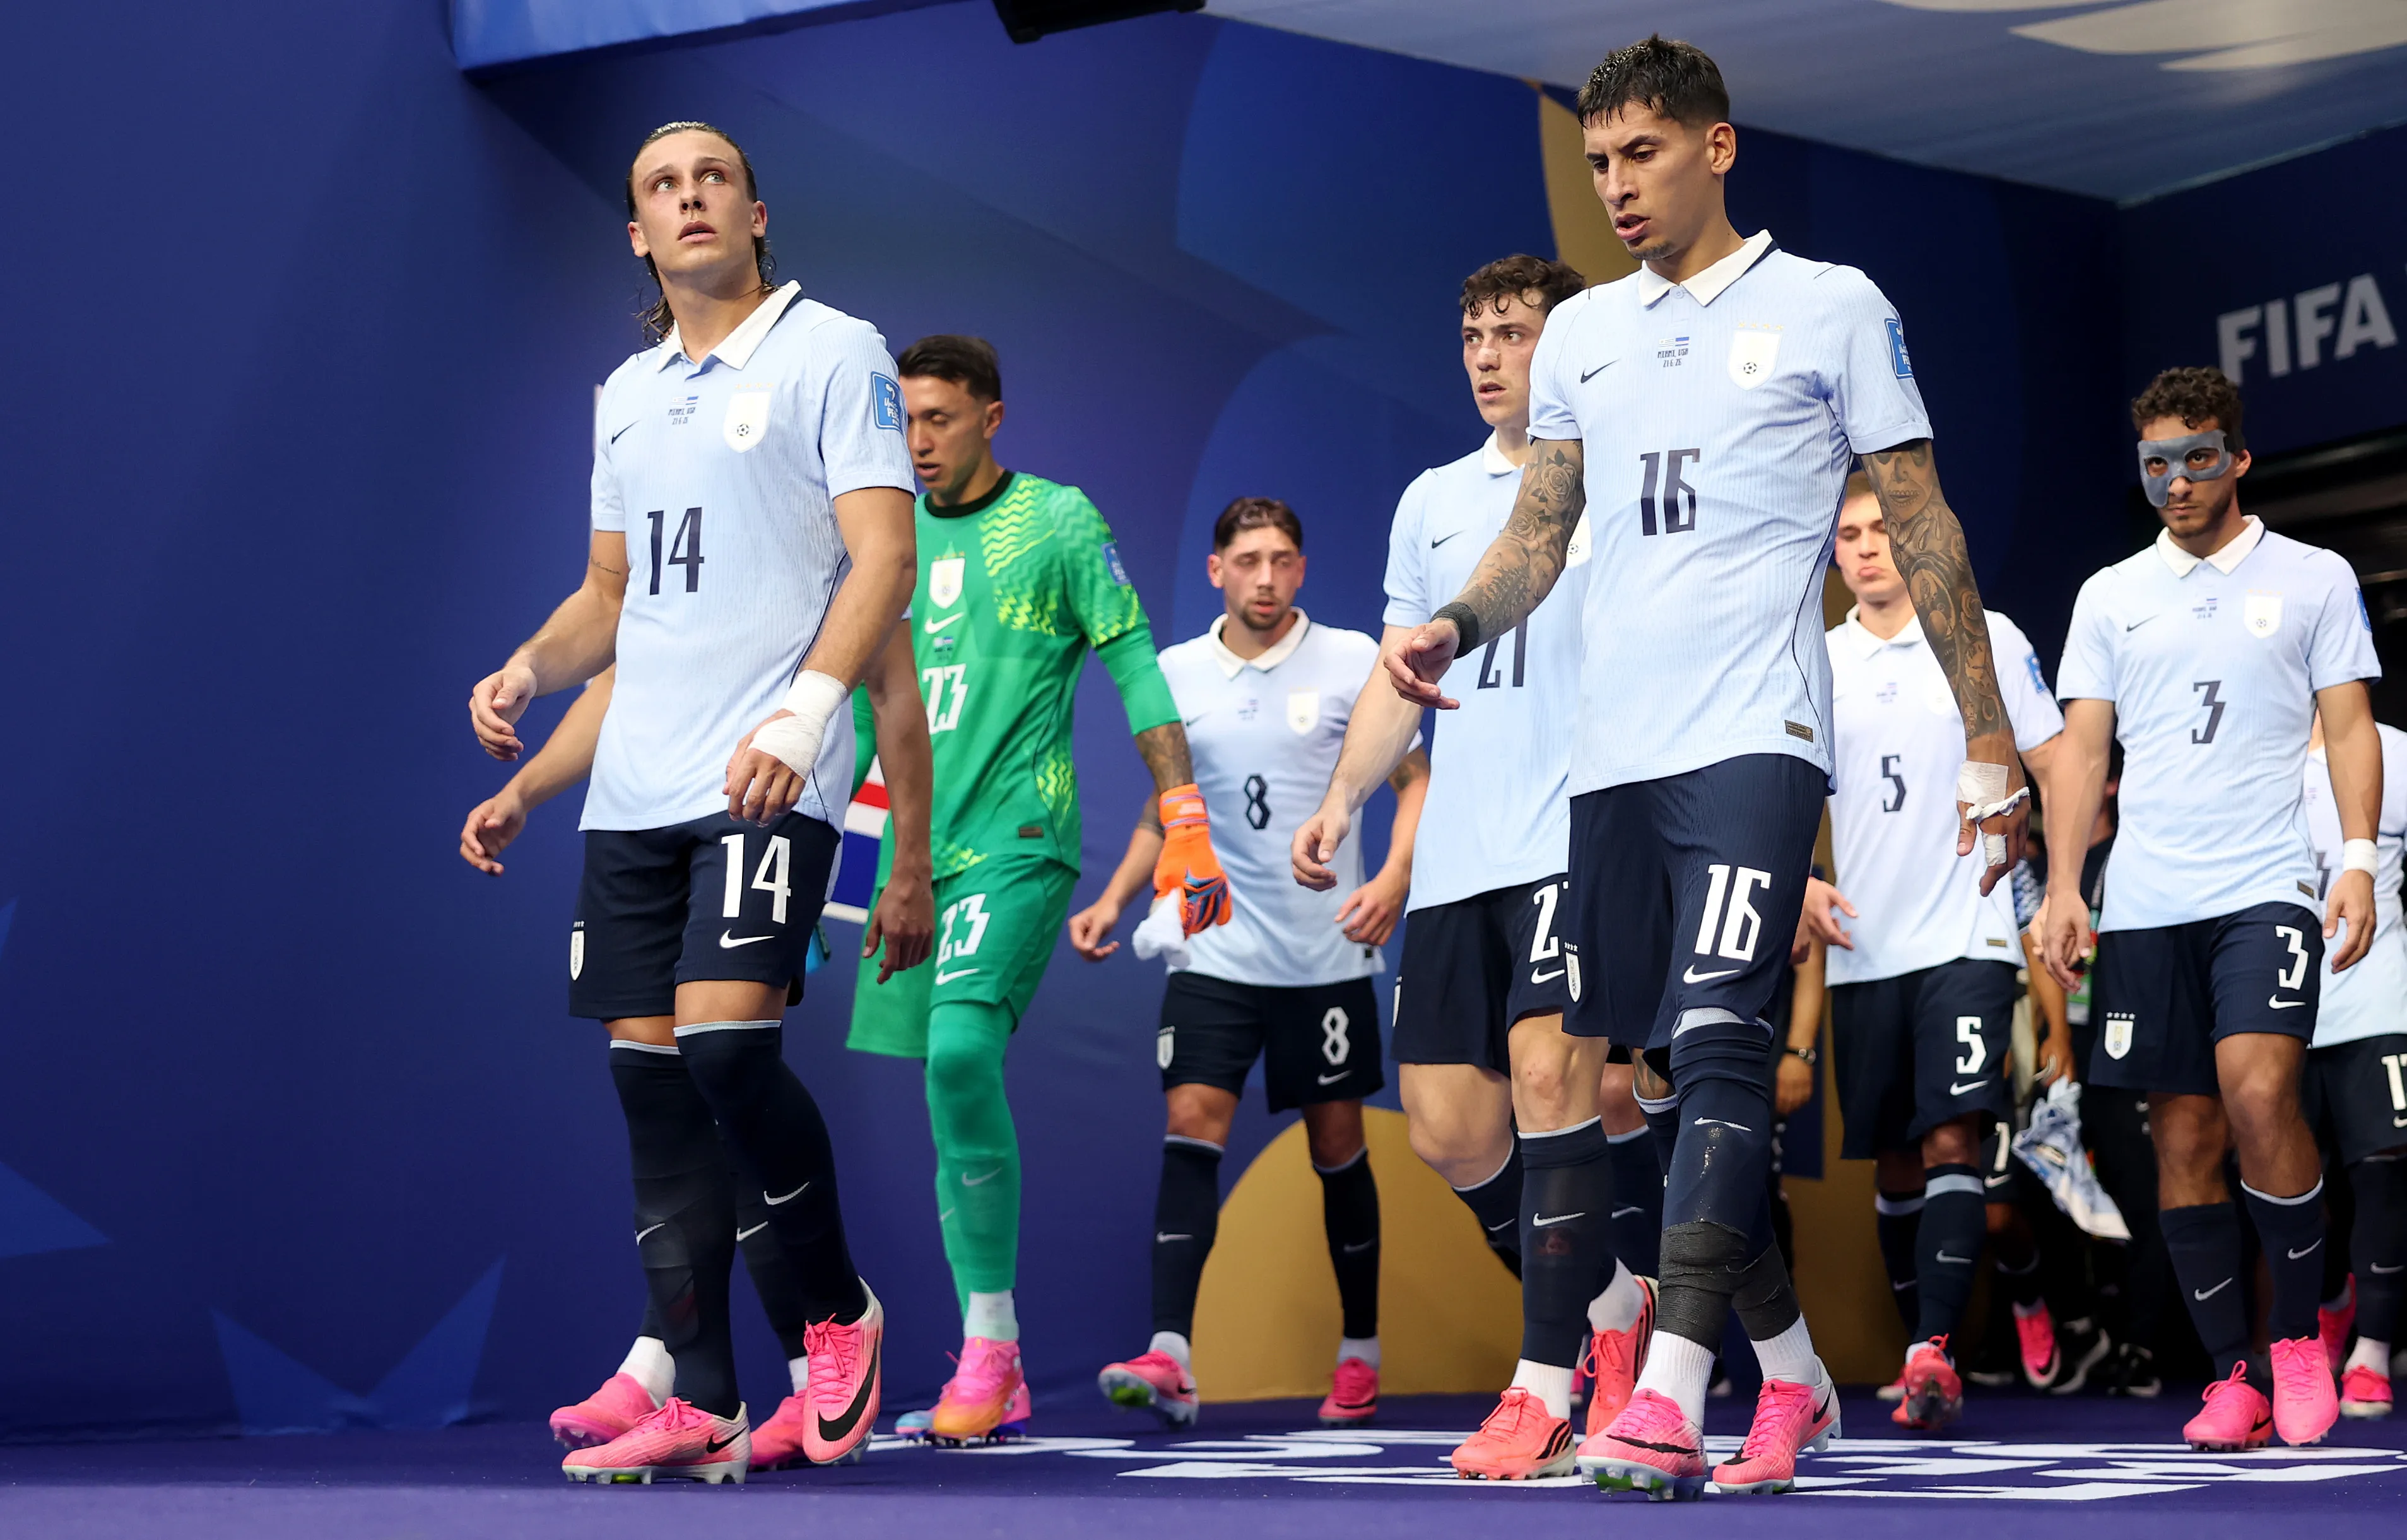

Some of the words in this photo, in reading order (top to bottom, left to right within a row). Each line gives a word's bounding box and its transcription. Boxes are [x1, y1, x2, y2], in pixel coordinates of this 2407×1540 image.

[2216, 273, 2398, 387] FIFA
[1640, 448, 1700, 536] 16
[647, 507, 705, 596] 14
[922, 663, 968, 735] 23
[2192, 680, 2226, 744] 3
[1245, 775, 1271, 830] 8
[1881, 755, 1907, 813] 5
[721, 833, 791, 924] 14
[1694, 864, 1772, 962] 16
[935, 893, 991, 968] 23
[1529, 881, 1569, 963] 2
[2275, 925, 2309, 990] 3
[1322, 1006, 1350, 1066] 8
[1956, 1016, 1987, 1074] 5
[2381, 1053, 2407, 1111] 1
